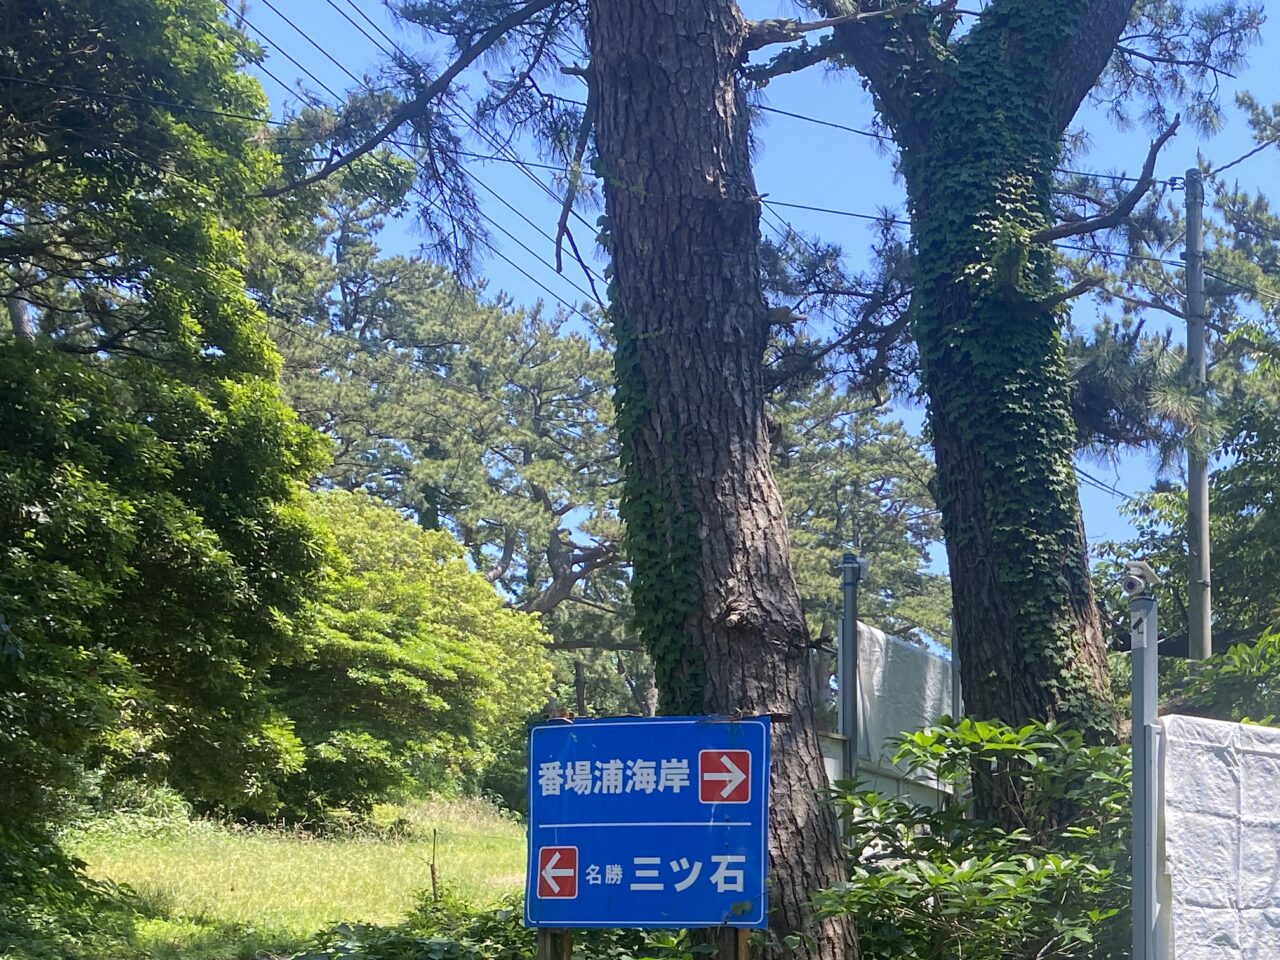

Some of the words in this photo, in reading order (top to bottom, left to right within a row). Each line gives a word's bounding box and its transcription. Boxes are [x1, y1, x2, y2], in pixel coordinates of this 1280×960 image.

[538, 758, 690, 796] 番場浦海岸
[585, 864, 623, 885] 名勝
[630, 855, 746, 893] 三ツ石
